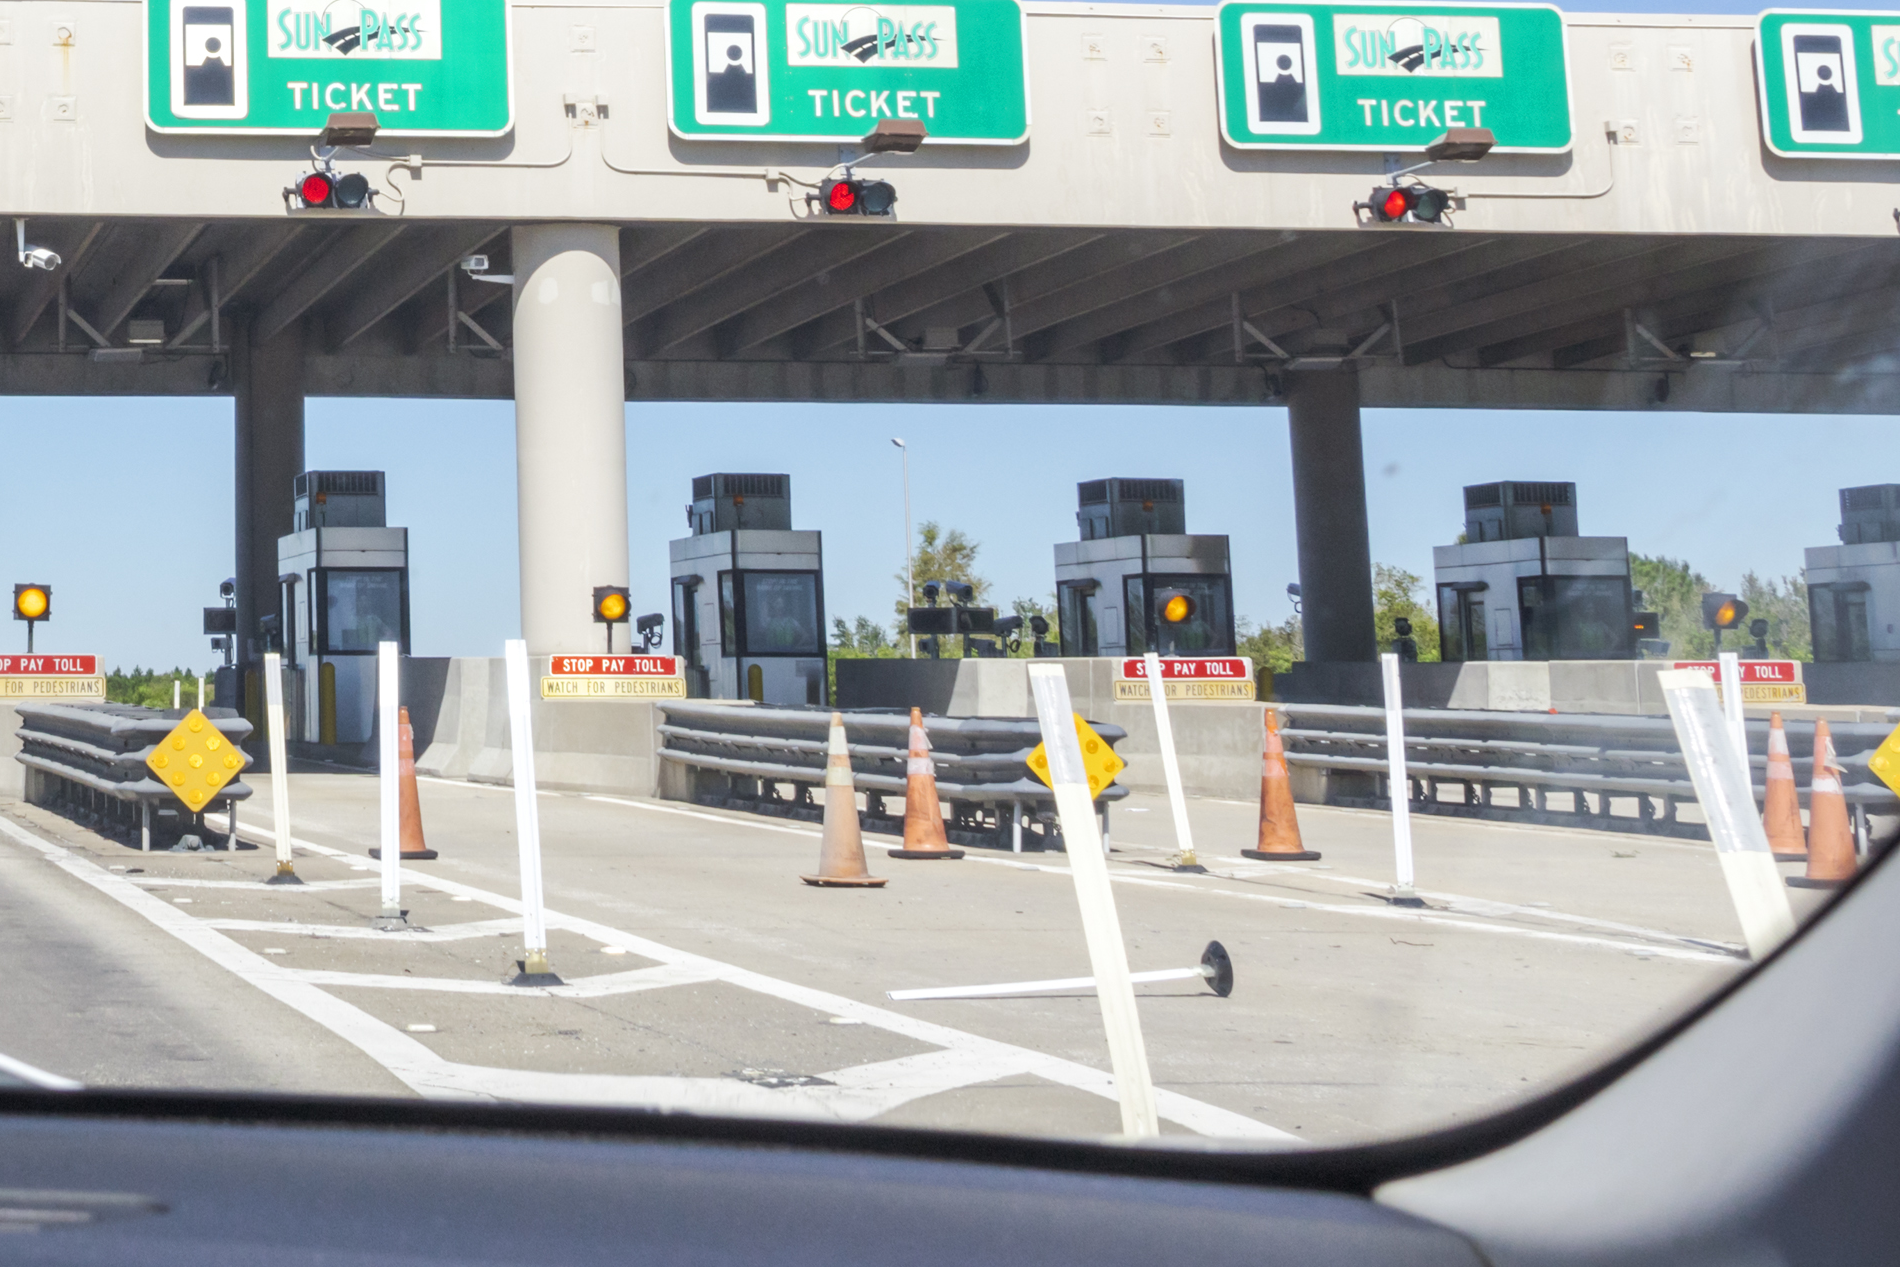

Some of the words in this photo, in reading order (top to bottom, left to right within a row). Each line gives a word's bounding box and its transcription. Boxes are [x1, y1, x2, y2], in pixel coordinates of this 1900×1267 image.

[277, 7, 332, 51] SUN
[360, 8, 423, 52] PASS
[795, 15, 849, 60] SUN
[876, 16, 938, 60] PASS
[1343, 25, 1396, 69] SUN
[1421, 26, 1484, 70] PASS
[287, 81, 423, 111] TICKET
[807, 89, 941, 118] TICKET
[1357, 98, 1487, 128] TICKET
[20, 658, 44, 671] PAY
[53, 658, 84, 672] TOLL
[563, 659, 593, 672] STOP
[602, 659, 625, 672] PAY
[634, 659, 664, 672] TOLL
[1174, 662, 1196, 675] PAY
[1205, 662, 1233, 675] TOLL
[1754, 666, 1782, 678] TOLL
[5, 681, 23, 693] FOR
[33, 681, 100, 694] PEDESTRIANS
[547, 681, 578, 694] WATCH
[587, 681, 605, 693] FOR
[615, 681, 680, 694] PEDESTRIANS
[1120, 684, 1149, 696] WATCH
[1185, 684, 1248, 696] PEDESTRIANS
